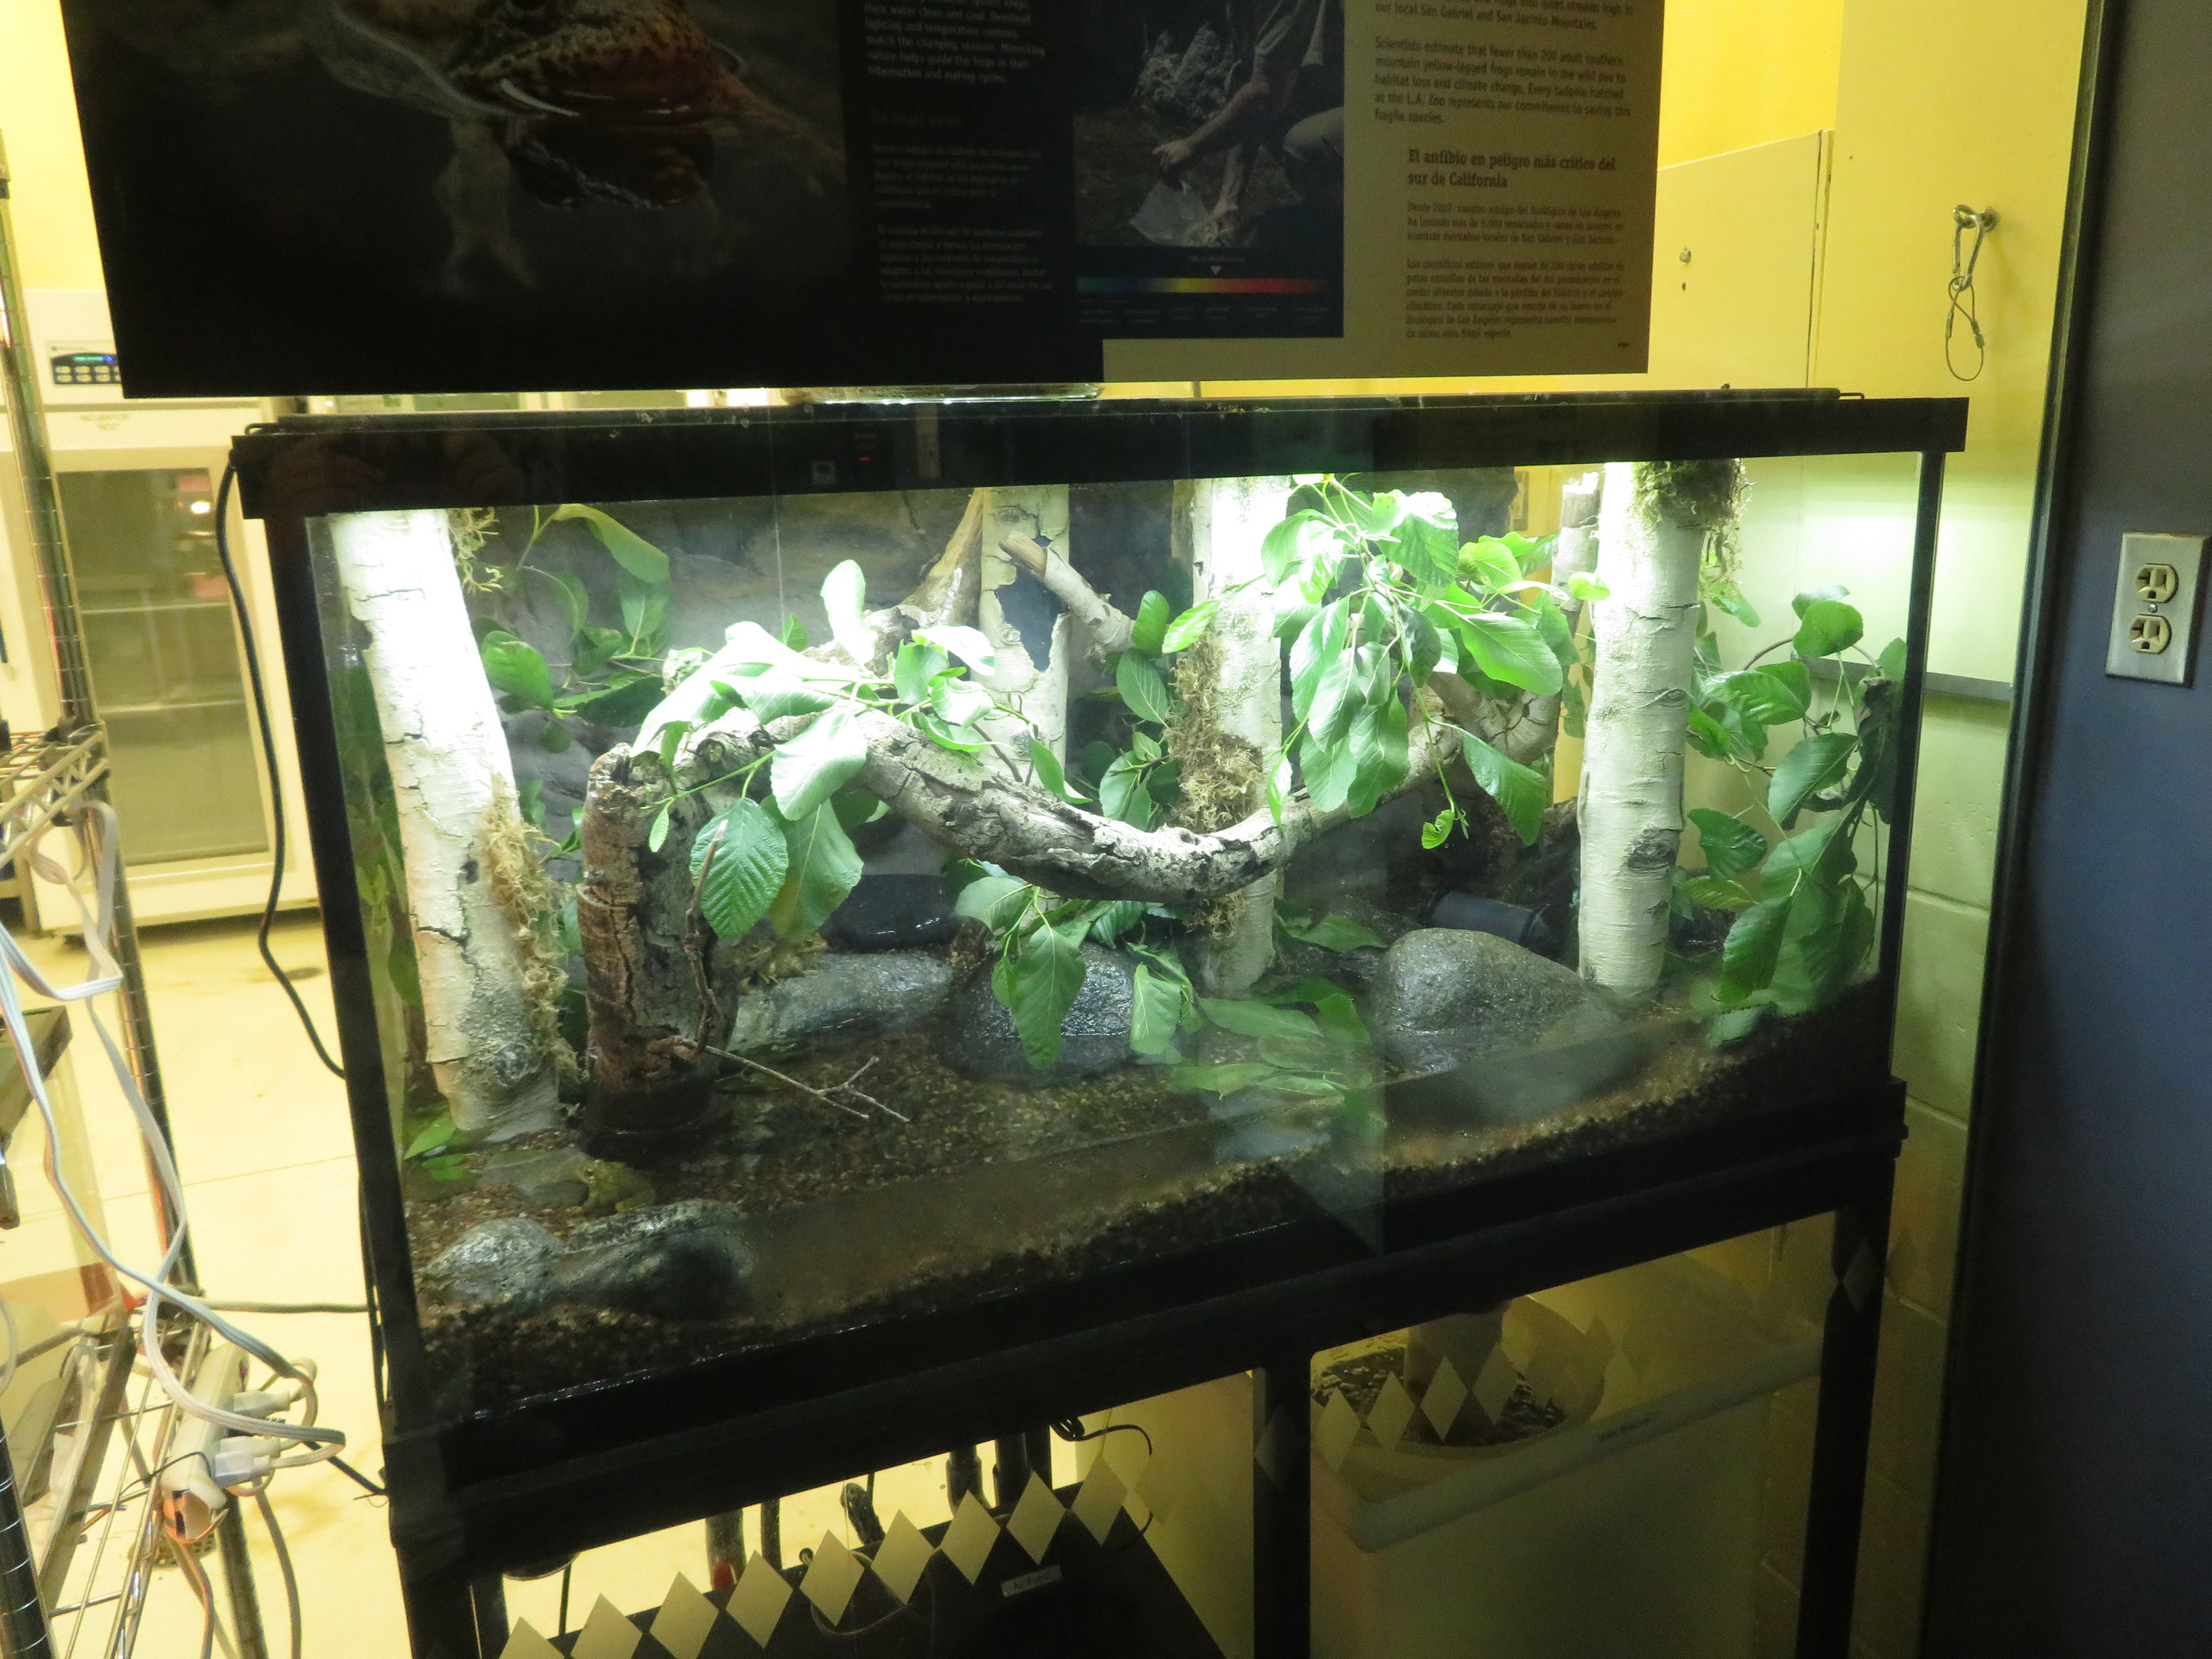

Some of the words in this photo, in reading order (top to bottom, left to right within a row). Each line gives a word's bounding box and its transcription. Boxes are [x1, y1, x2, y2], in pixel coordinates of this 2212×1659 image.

[1395, 2, 1417, 15] local
[1441, 5, 1473, 20] Gabriel
[1515, 12, 1548, 26] Jacinto
[1551, 15, 1598, 30] Mountains.
[926, 24, 979, 35] temperature
[1375, 36, 1421, 51] Scientists
[1424, 41, 1464, 55] estimate
[1490, 45, 1514, 58] fewer
[1517, 47, 1538, 60] than
[1560, 51, 1582, 63] adult
[1585, 53, 1623, 65] southern
[1376, 58, 1419, 68] mountain
[1423, 59, 1487, 75] yellow-legged
[1491, 61, 1512, 78] frogs
[1515, 66, 1545, 77] remain
[1376, 73, 1409, 86] habitat
[1454, 78, 1488, 91] climate
[1491, 81, 1525, 96] change.
[1528, 82, 1551, 98] Every
[1375, 108, 1405, 124] fragile
[1408, 111, 1444, 124] species.
[1449, 98, 1495, 110] represents
[1515, 101, 1569, 113] commitment
[1584, 105, 1612, 118] saving
[1409, 149, 1420, 163] El
[1424, 149, 1467, 165] anfibio
[1471, 154, 1485, 166] en
[1489, 152, 1530, 171] peligro
[1534, 154, 1556, 168] más
[1560, 155, 1595, 170] crítico
[1598, 156, 1616, 171] del
[1408, 173, 1428, 185] sur
[1431, 171, 1445, 186] de
[1449, 172, 1508, 187] California
